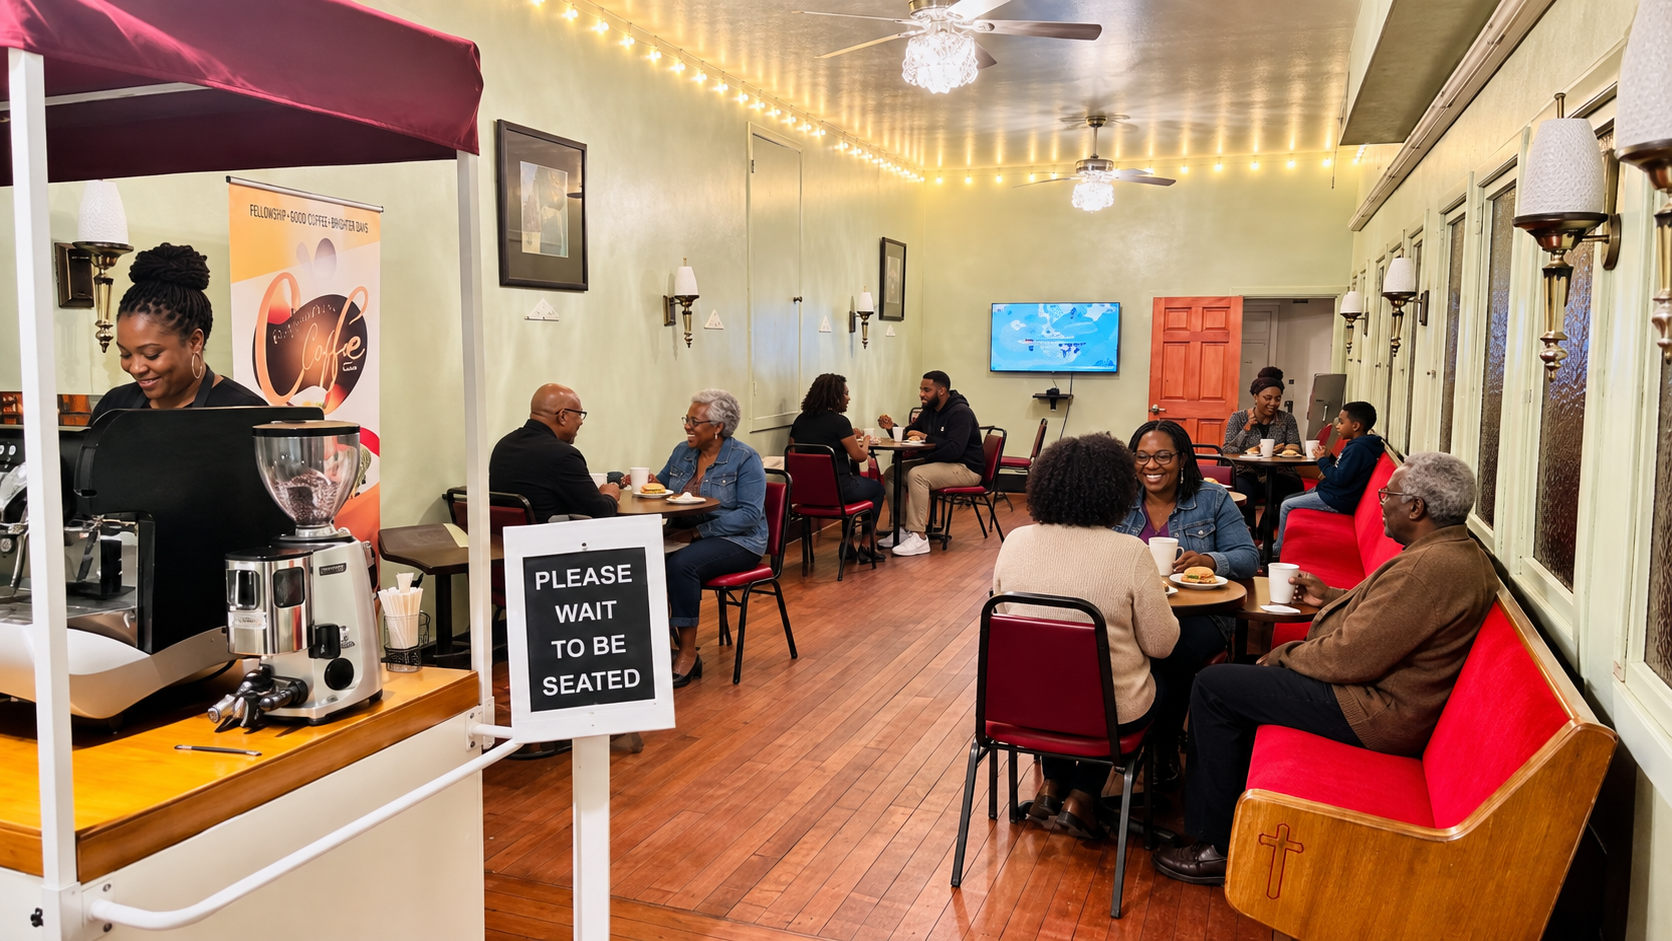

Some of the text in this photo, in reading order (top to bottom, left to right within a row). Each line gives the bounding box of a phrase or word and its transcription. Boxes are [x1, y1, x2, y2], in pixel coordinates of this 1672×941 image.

[250, 204, 286, 221] FELLOWSHIP
[290, 210, 307, 224] GOOD
[308, 213, 328, 228] COFFEE
[535, 564, 633, 590] PLEASE
[555, 600, 617, 624] WAIT
[551, 634, 627, 659] TO BE
[542, 668, 641, 697] SEATED
